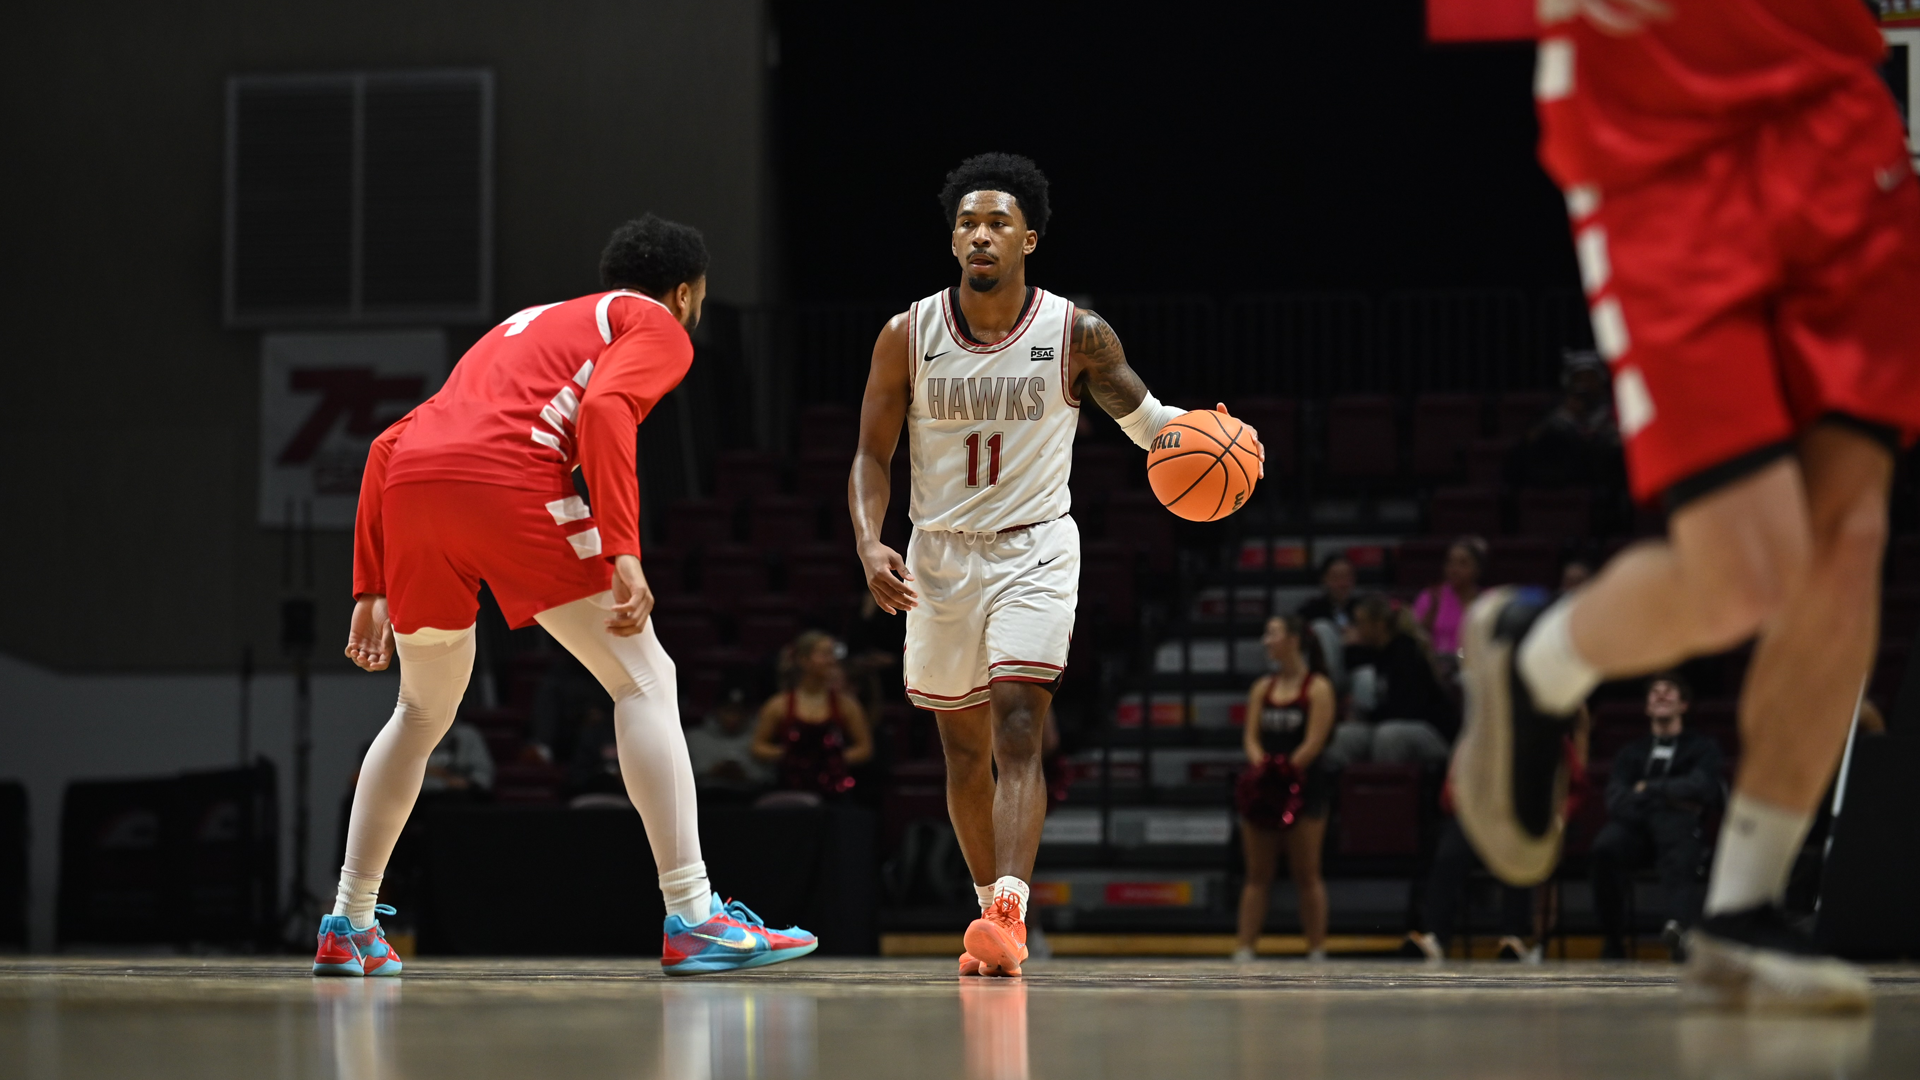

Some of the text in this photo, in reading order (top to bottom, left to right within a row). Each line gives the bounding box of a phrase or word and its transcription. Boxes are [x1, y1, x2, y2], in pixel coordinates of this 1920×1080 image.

[1030, 349, 1055, 358] PSAC
[927, 376, 1046, 421] HAWKS
[963, 430, 1004, 489] 11
